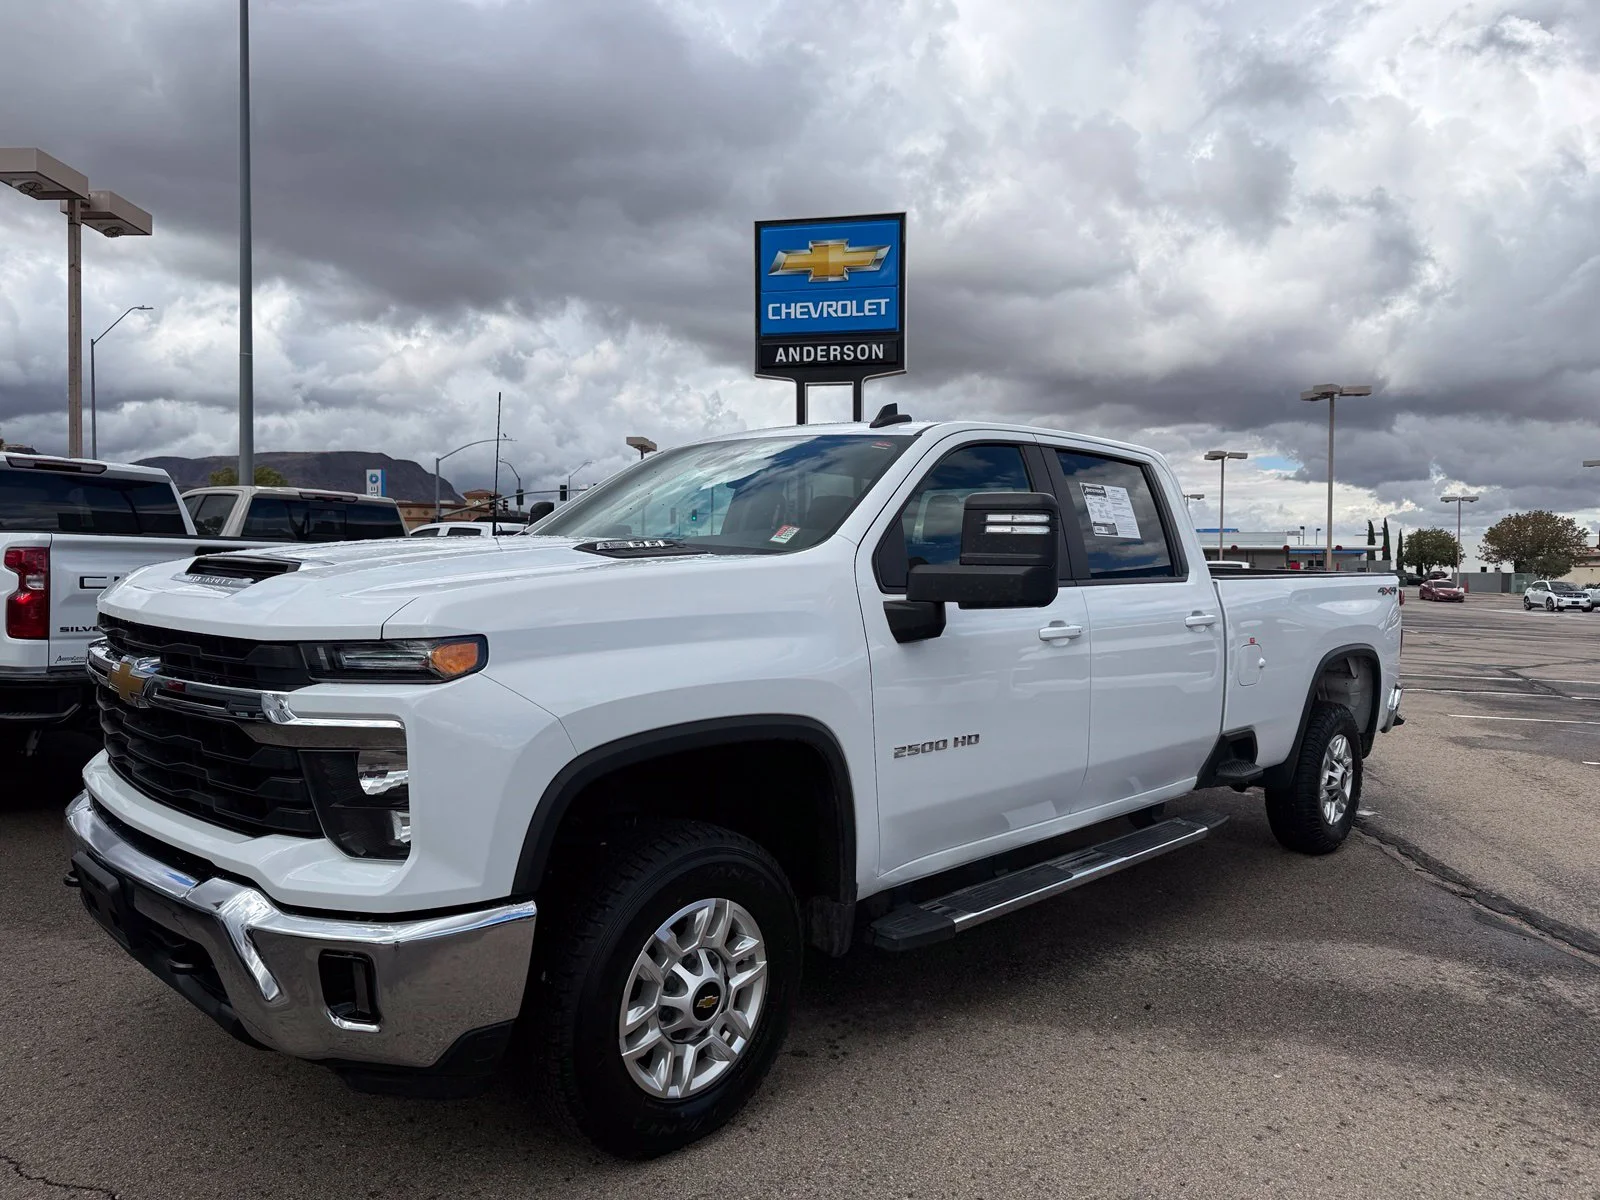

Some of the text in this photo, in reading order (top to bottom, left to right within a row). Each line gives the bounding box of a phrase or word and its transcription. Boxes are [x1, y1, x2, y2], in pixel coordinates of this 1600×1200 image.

[767, 298, 890, 320] CHEVROLET
[774, 343, 885, 363] ANDERSON
[893, 733, 980, 759] 2500 HD
